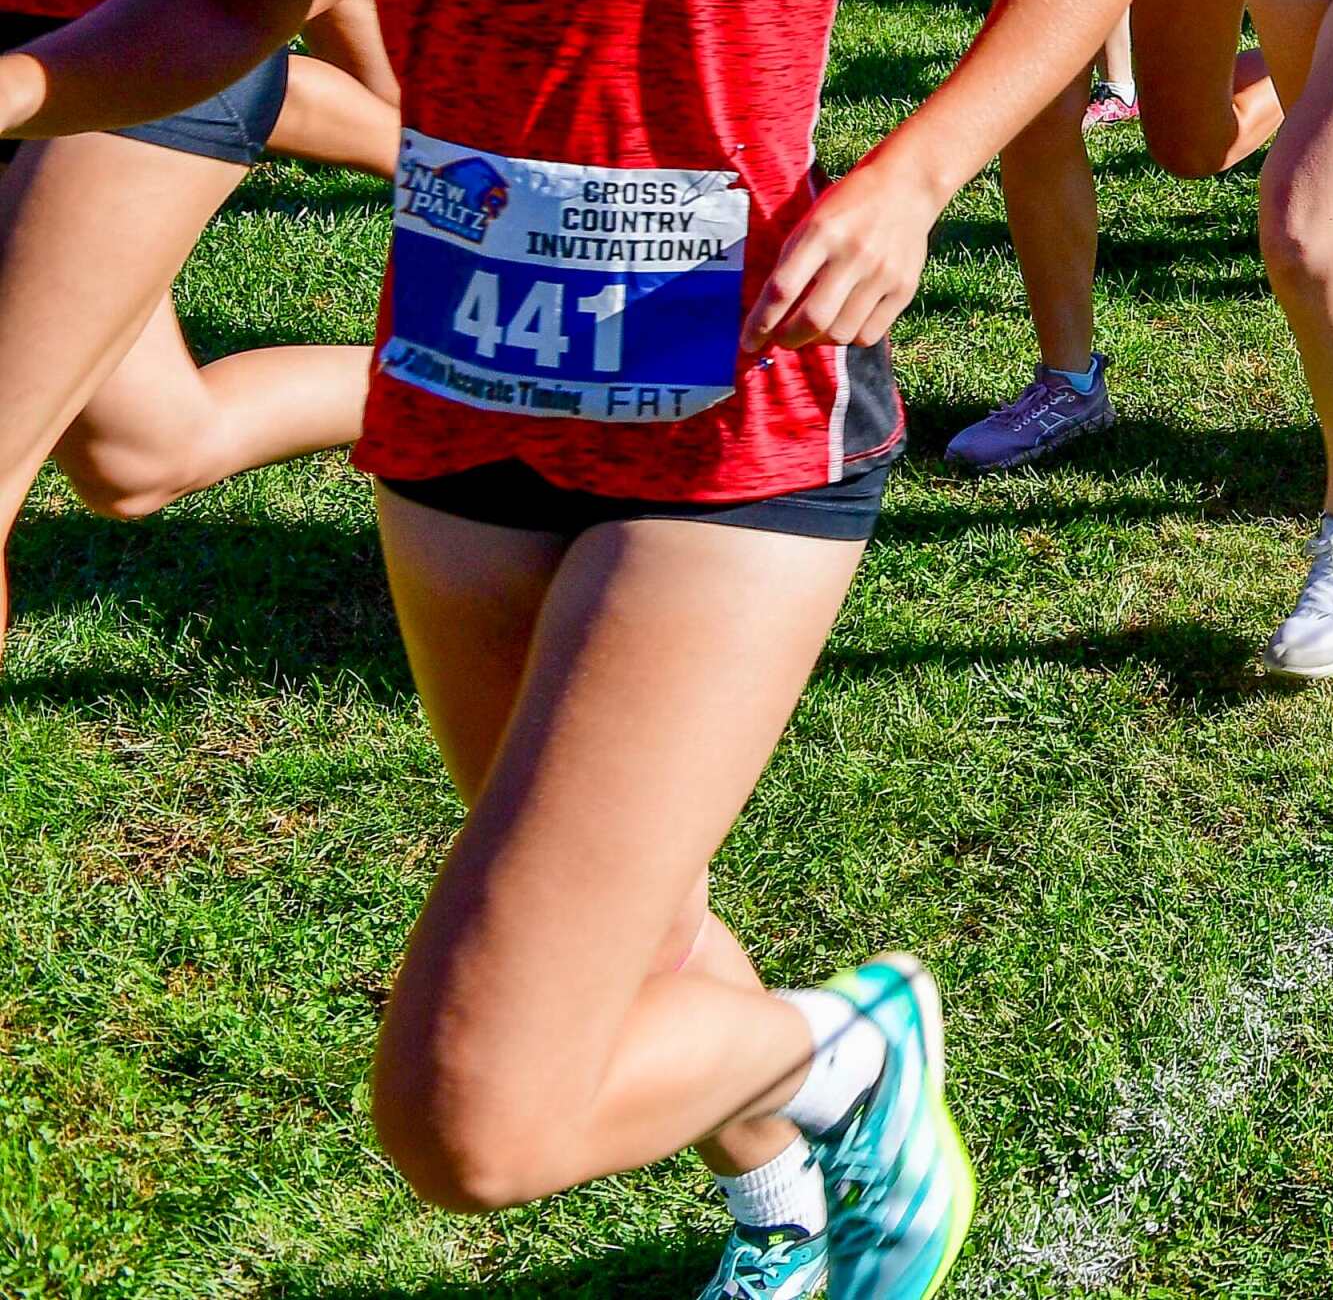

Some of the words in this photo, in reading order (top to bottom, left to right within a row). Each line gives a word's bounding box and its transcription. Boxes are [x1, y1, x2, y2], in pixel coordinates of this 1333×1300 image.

[409, 169, 467, 203] NEW
[583, 180, 678, 205] CROSS
[411, 192, 488, 231] PALTZ
[562, 207, 694, 234] COUNTRY
[527, 231, 730, 263] INVITATIONAL
[452, 270, 627, 373] 441
[607, 387, 691, 417] FAT
